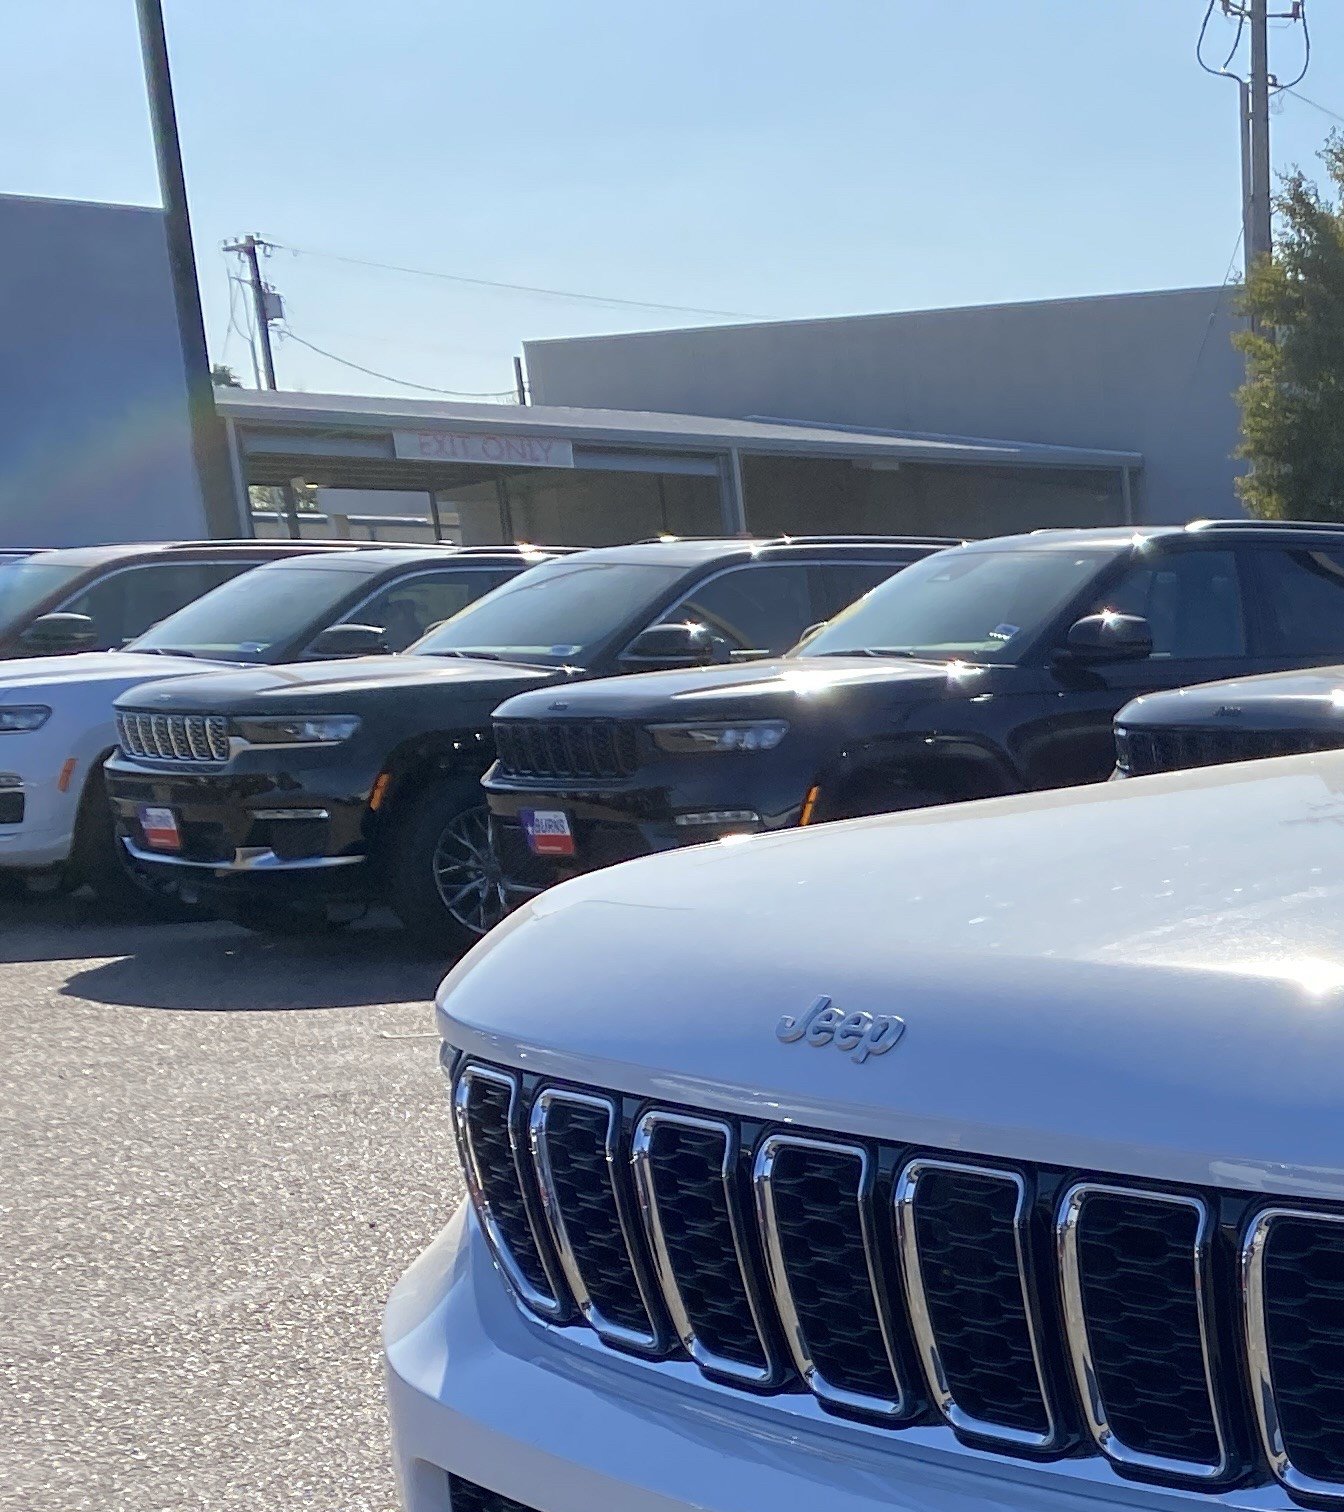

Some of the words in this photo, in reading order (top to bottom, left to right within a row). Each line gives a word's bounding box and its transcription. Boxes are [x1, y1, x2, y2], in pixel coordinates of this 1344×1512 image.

[418, 434, 471, 457] EXIT
[482, 437, 552, 464] ONLY
[775, 994, 906, 1065] Jeep
